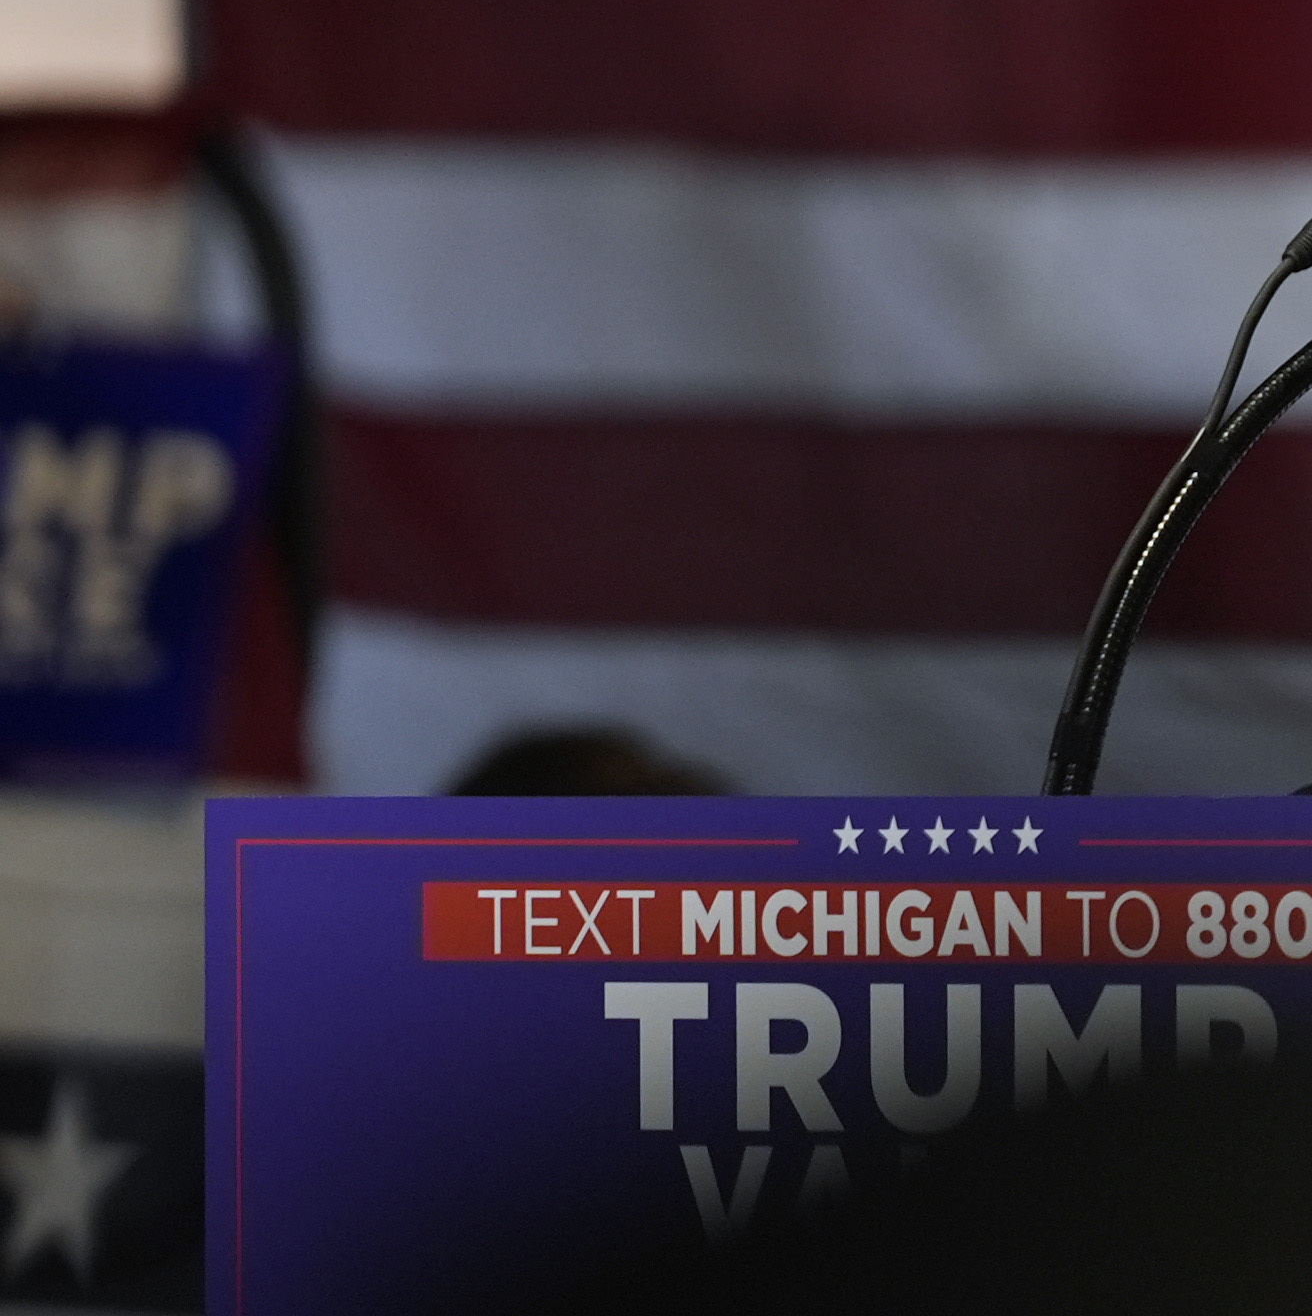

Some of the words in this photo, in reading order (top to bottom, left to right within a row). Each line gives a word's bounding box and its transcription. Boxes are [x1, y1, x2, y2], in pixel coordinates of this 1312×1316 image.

[477, 889, 655, 955] TEXT
[681, 888, 1041, 957] MICHIGAN
[1065, 890, 1159, 957] TO
